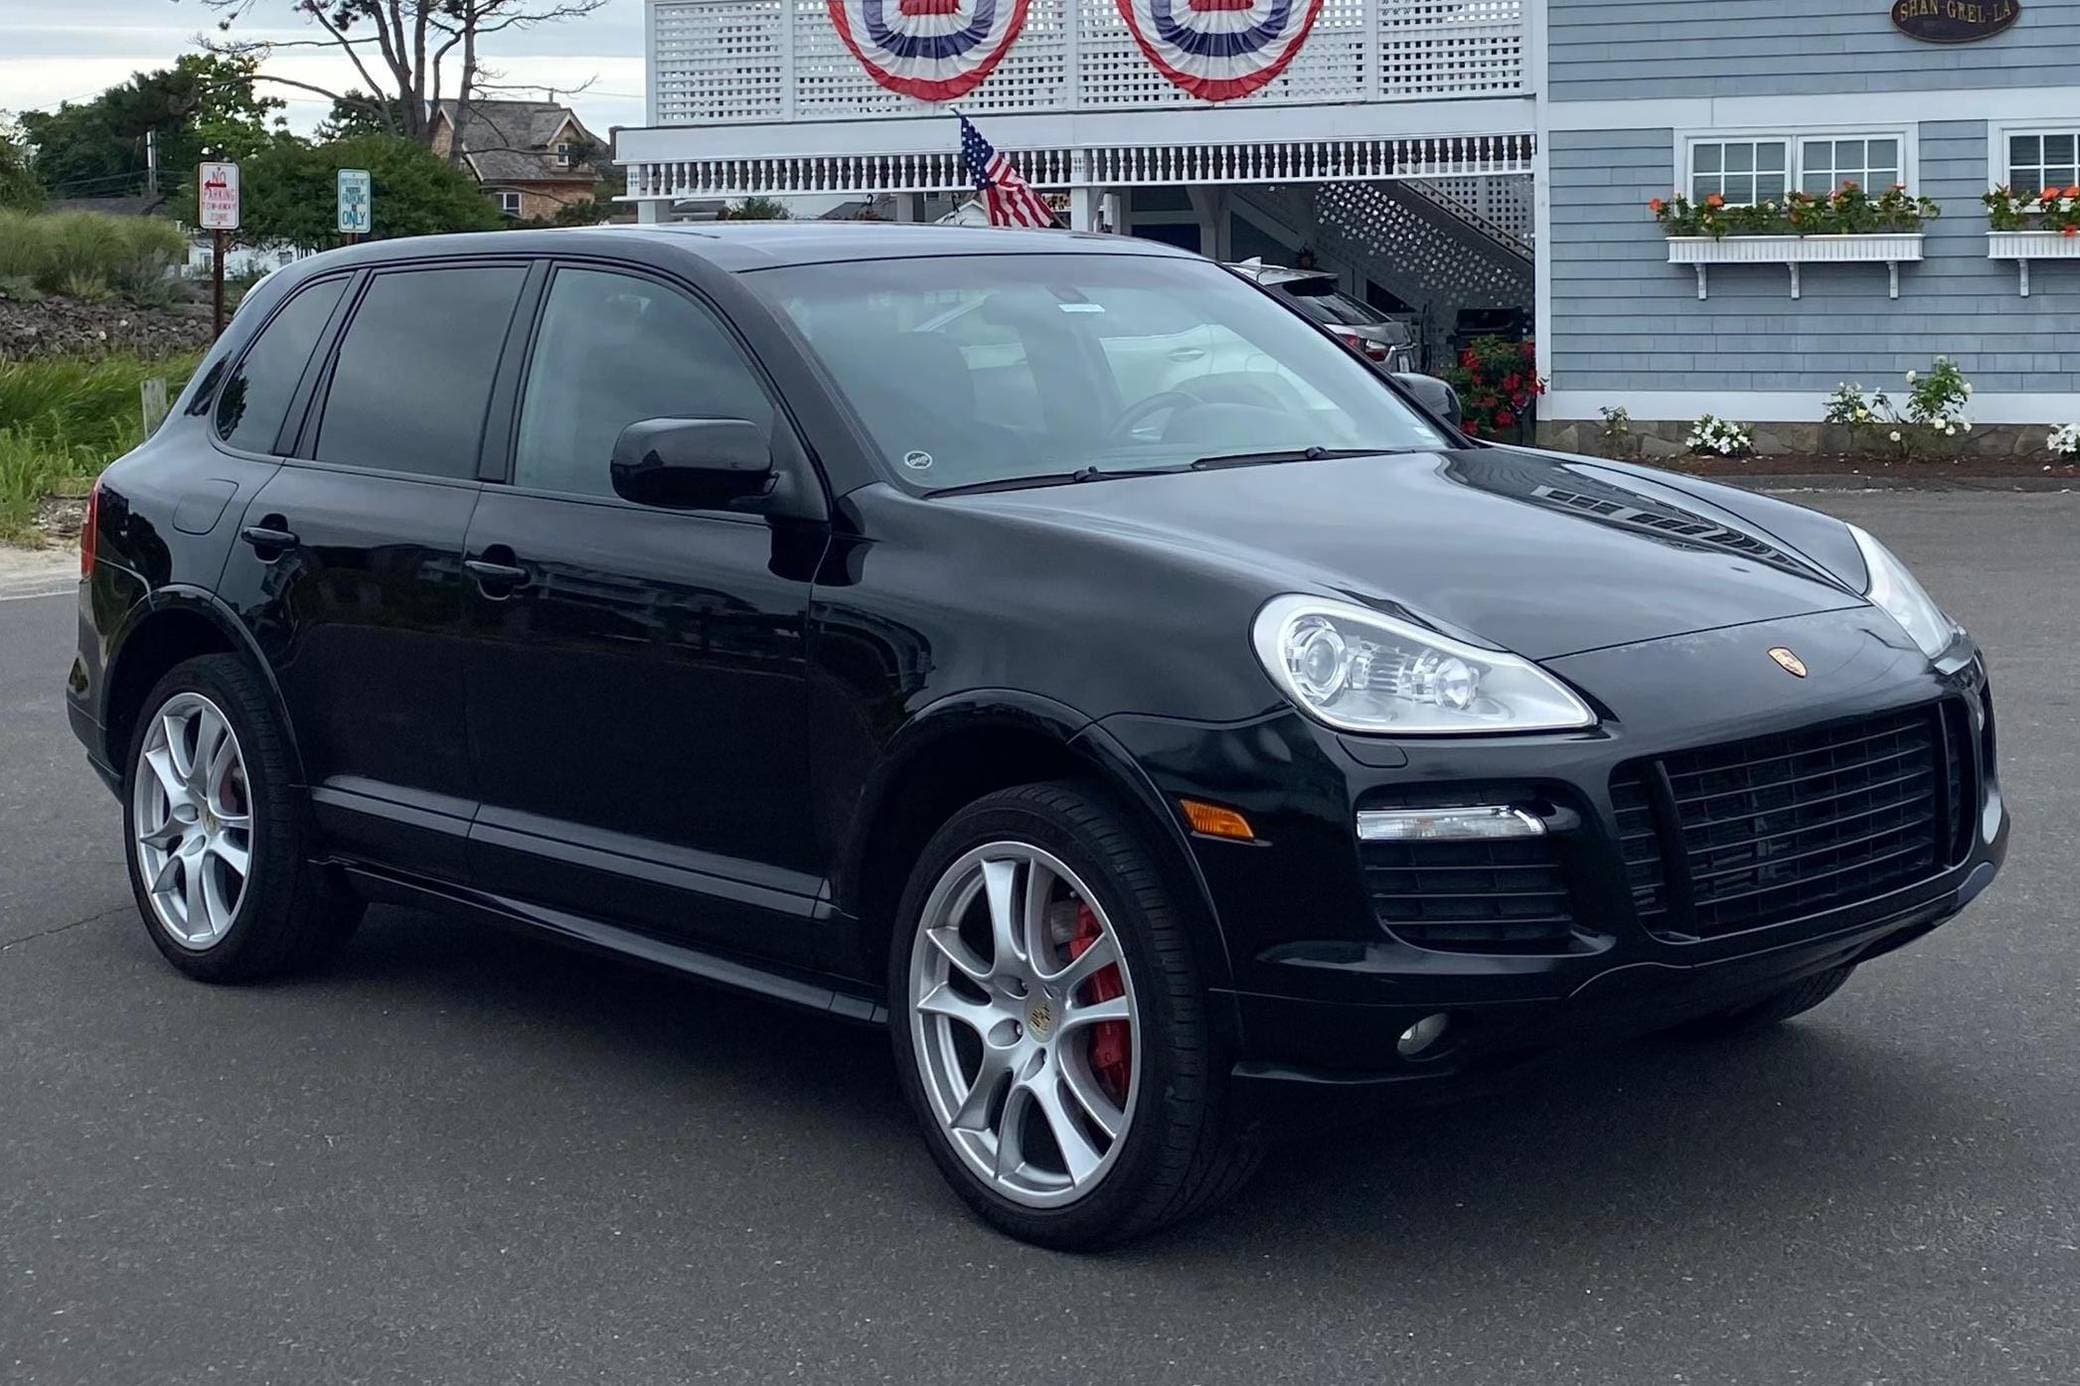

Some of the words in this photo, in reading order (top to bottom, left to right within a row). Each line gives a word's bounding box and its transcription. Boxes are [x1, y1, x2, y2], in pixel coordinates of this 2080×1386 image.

[212, 171, 226, 184] NO
[204, 188, 235, 201] PARKING
[343, 211, 366, 225] ONLY
